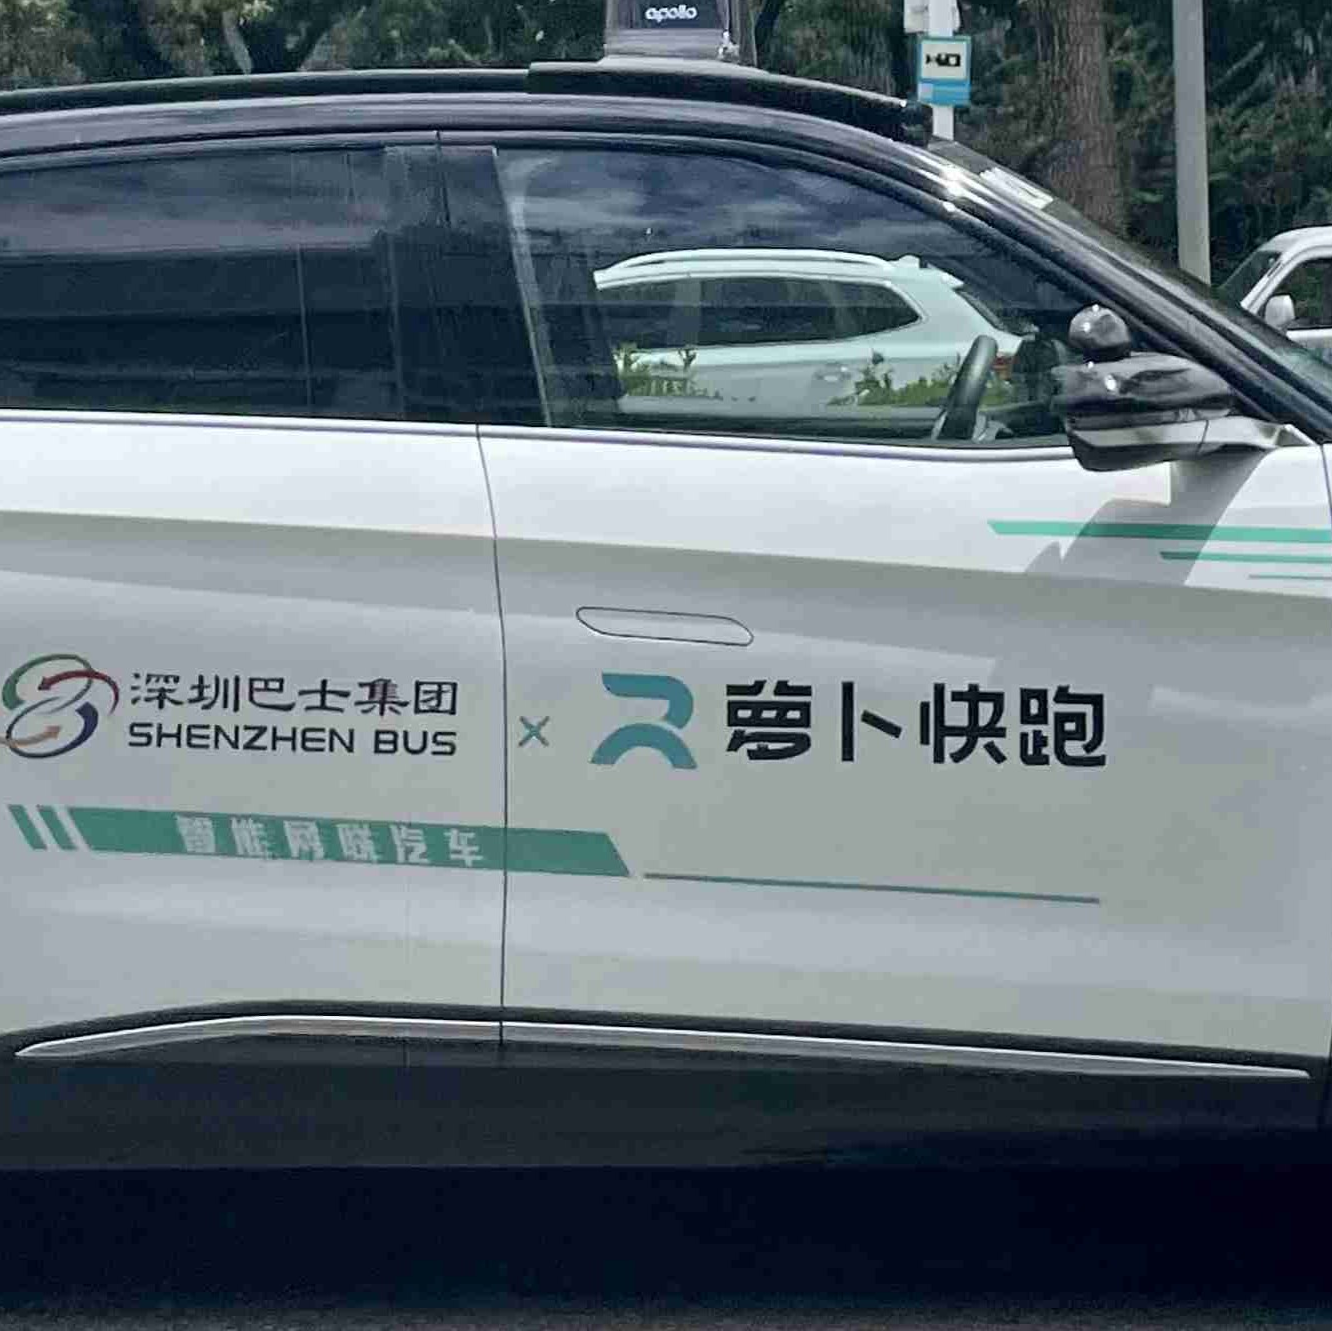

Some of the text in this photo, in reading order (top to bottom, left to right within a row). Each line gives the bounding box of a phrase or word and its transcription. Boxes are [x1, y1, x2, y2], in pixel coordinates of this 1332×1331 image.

[645, 3, 697, 24] apollo
[129, 671, 458, 717] 深圳巴士集团
[127, 722, 457, 756] SHENZHEN BUS
[725, 679, 1107, 767] 萝卜快跑
[175, 813, 484, 867] 智能网联汽车
